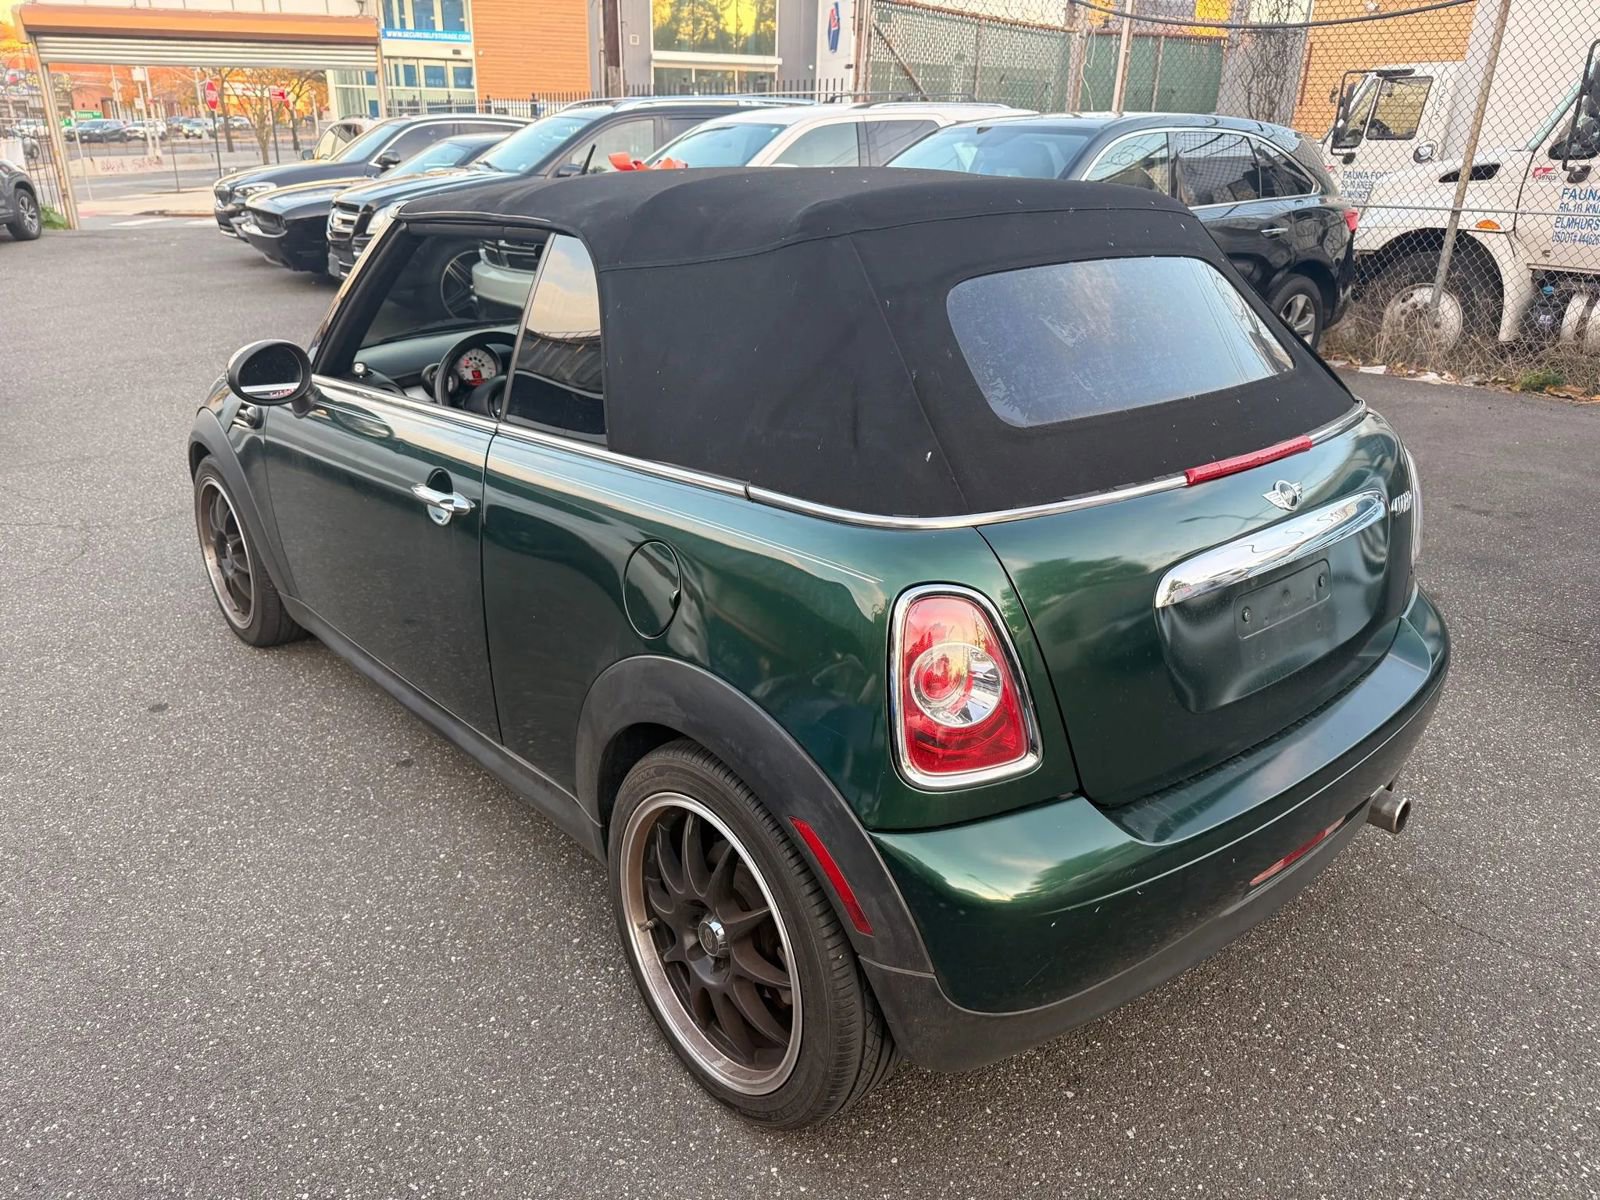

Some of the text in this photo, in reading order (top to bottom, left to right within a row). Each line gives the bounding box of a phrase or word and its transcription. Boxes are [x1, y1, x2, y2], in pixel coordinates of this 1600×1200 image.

[386, 30, 471, 41] WWW.SECURESELFSTORAGE.COM
[206, 90, 218, 101] STOP
[1343, 170, 1369, 180] FAUNA
